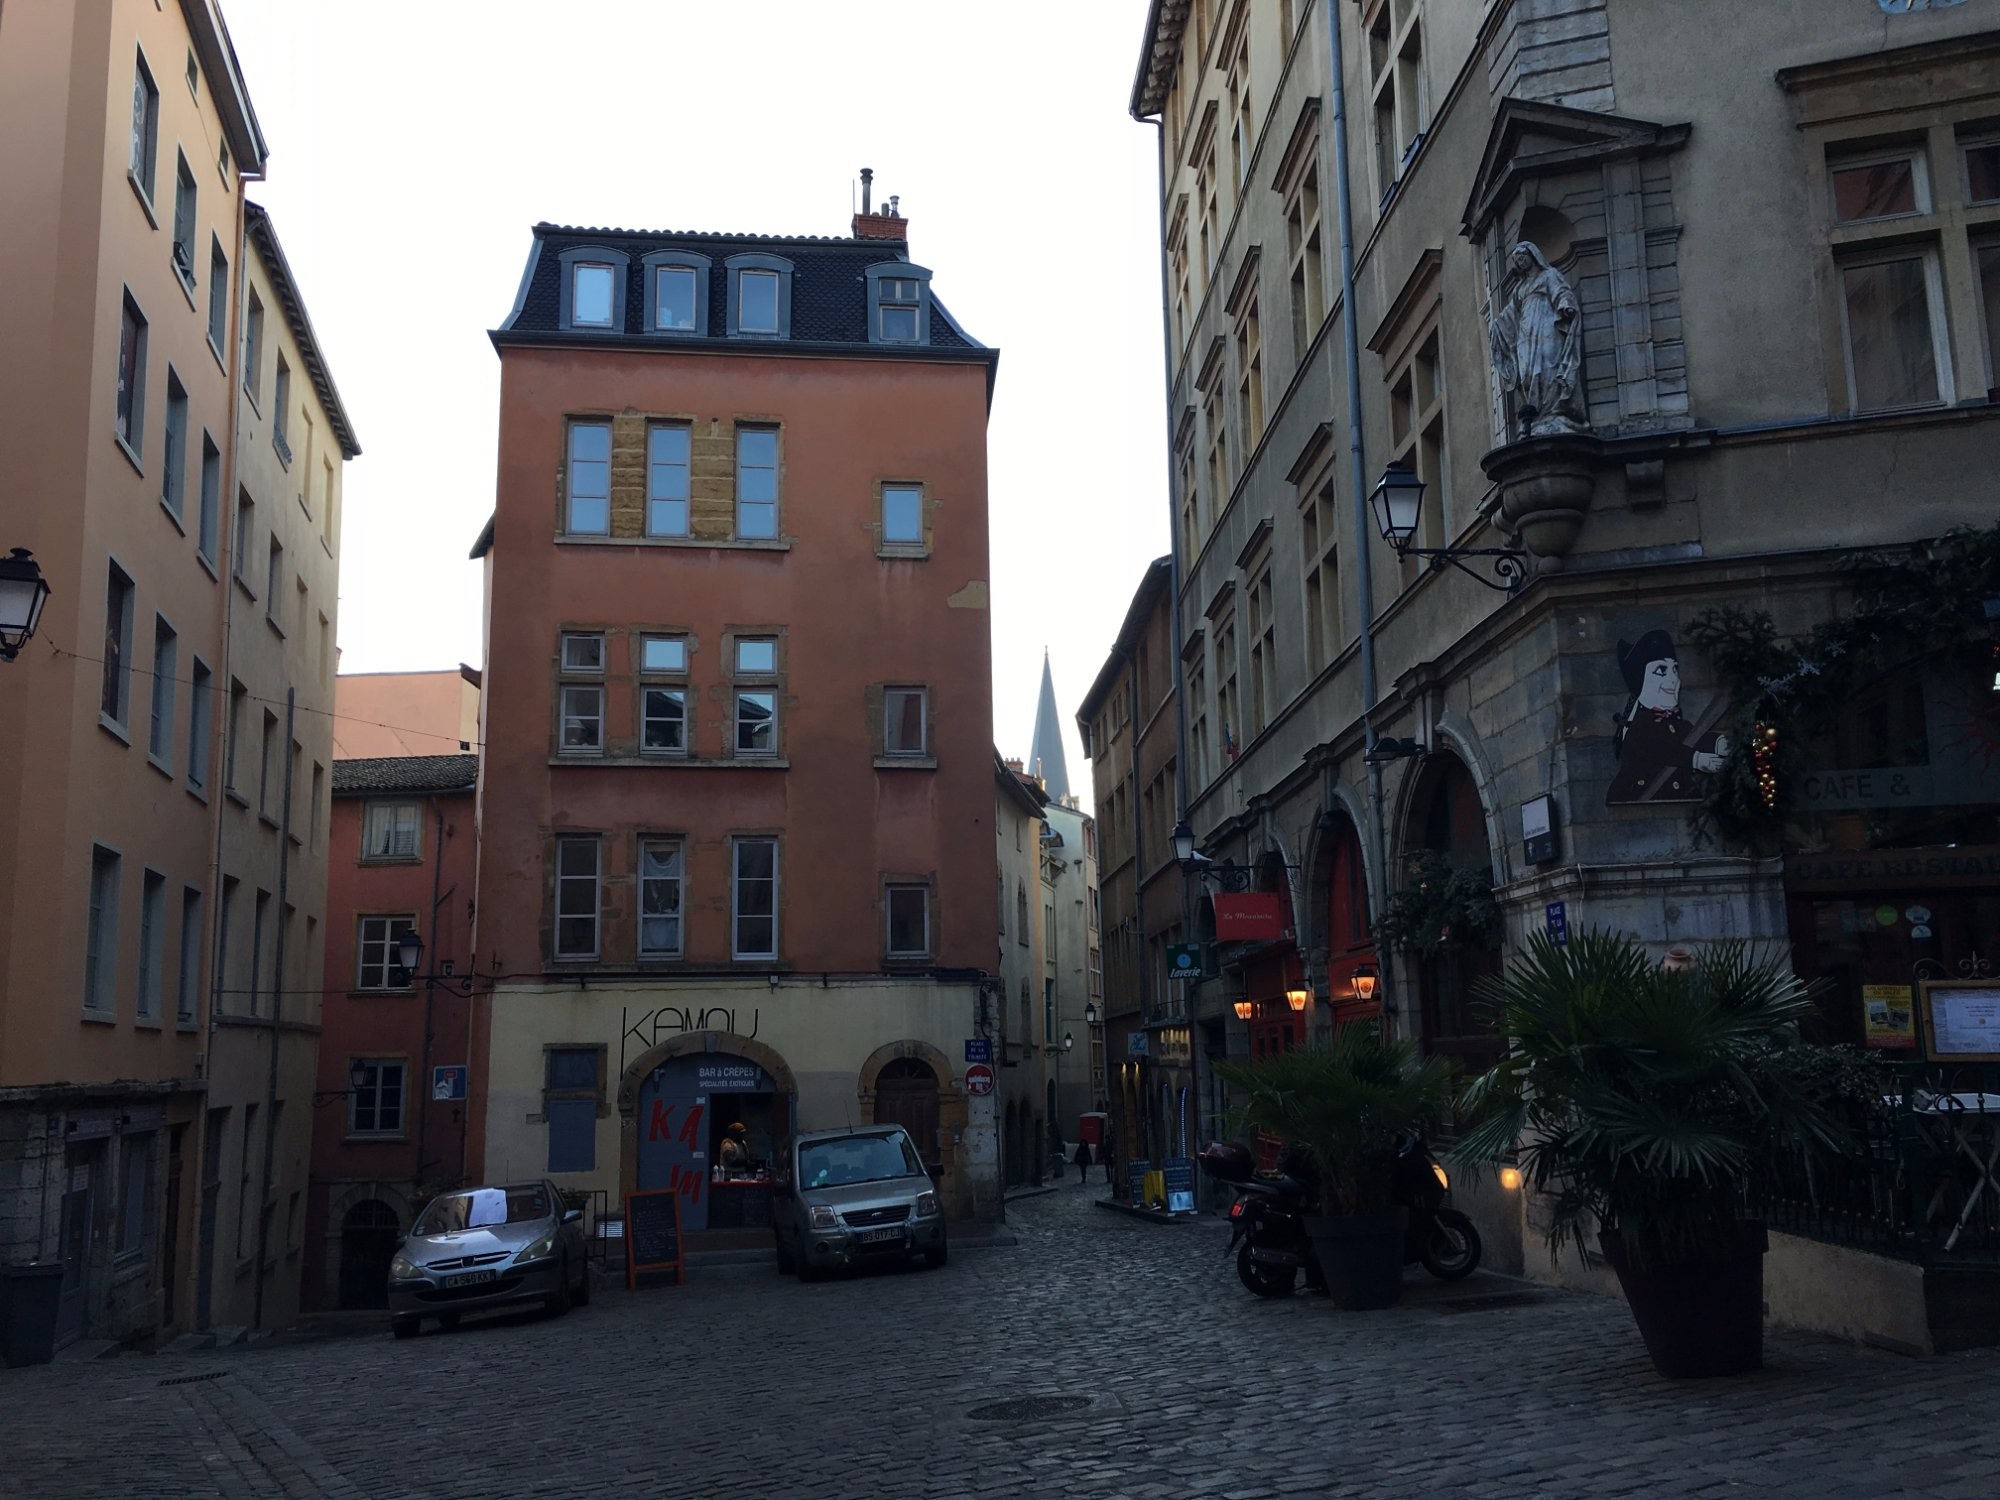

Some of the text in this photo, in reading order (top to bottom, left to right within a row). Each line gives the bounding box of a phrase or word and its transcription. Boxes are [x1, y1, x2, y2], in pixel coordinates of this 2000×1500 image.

[1889, 773, 1911, 797] &
[1169, 966, 1201, 978] Laverie
[698, 1067, 716, 1078] BAR
